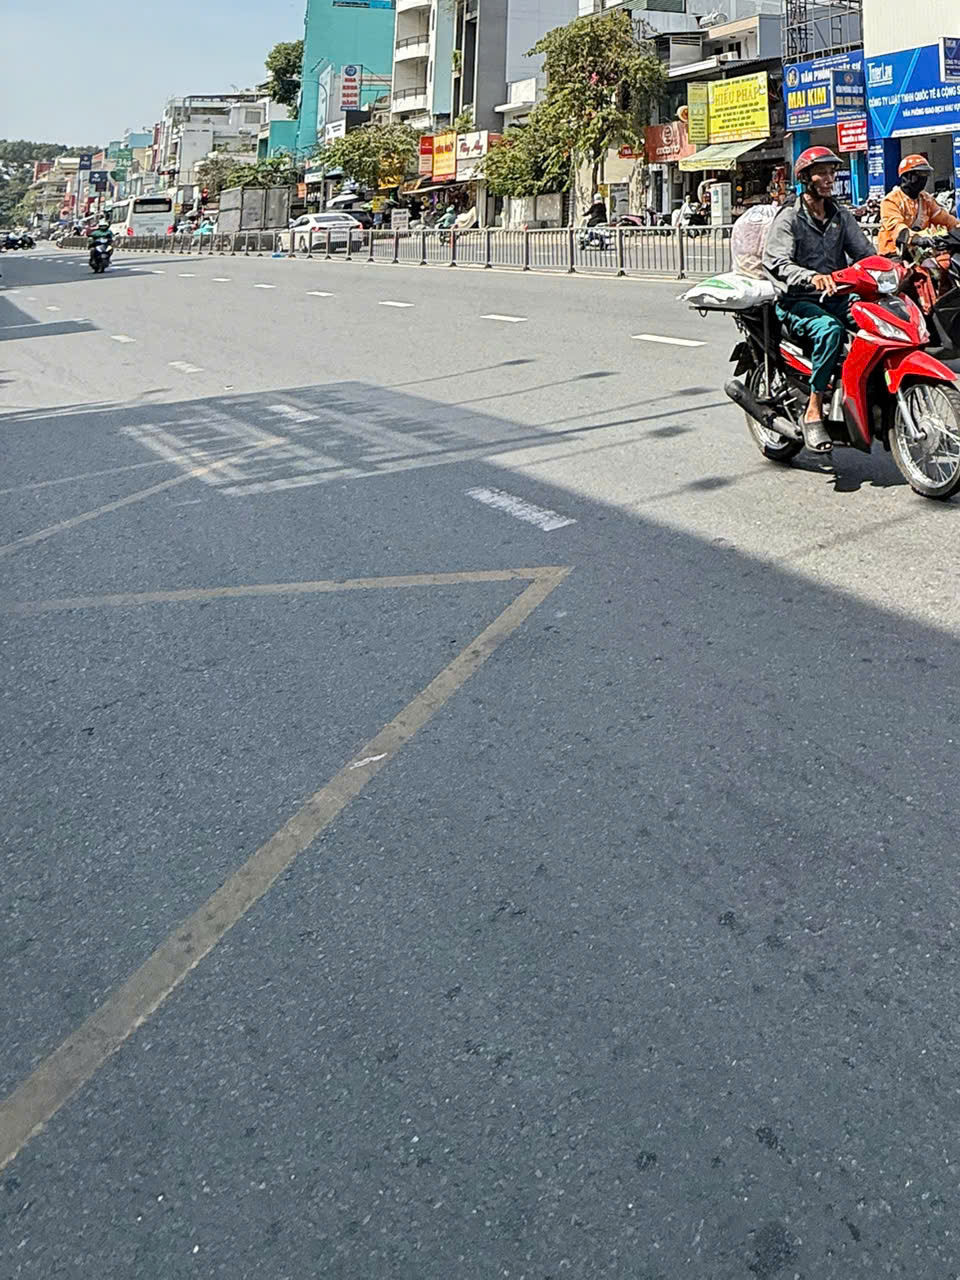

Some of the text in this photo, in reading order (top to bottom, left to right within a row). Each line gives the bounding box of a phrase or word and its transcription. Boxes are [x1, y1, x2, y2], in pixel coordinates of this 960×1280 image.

[787, 86, 827, 109] MAI KIM
[868, 95, 882, 108] CÔNG
[882, 97, 888, 106] TY
[888, 93, 901, 106] LUẬT
[914, 88, 929, 101] QUỐC
[929, 86, 936, 99] TẾ
[941, 86, 957, 99] CỘNG
